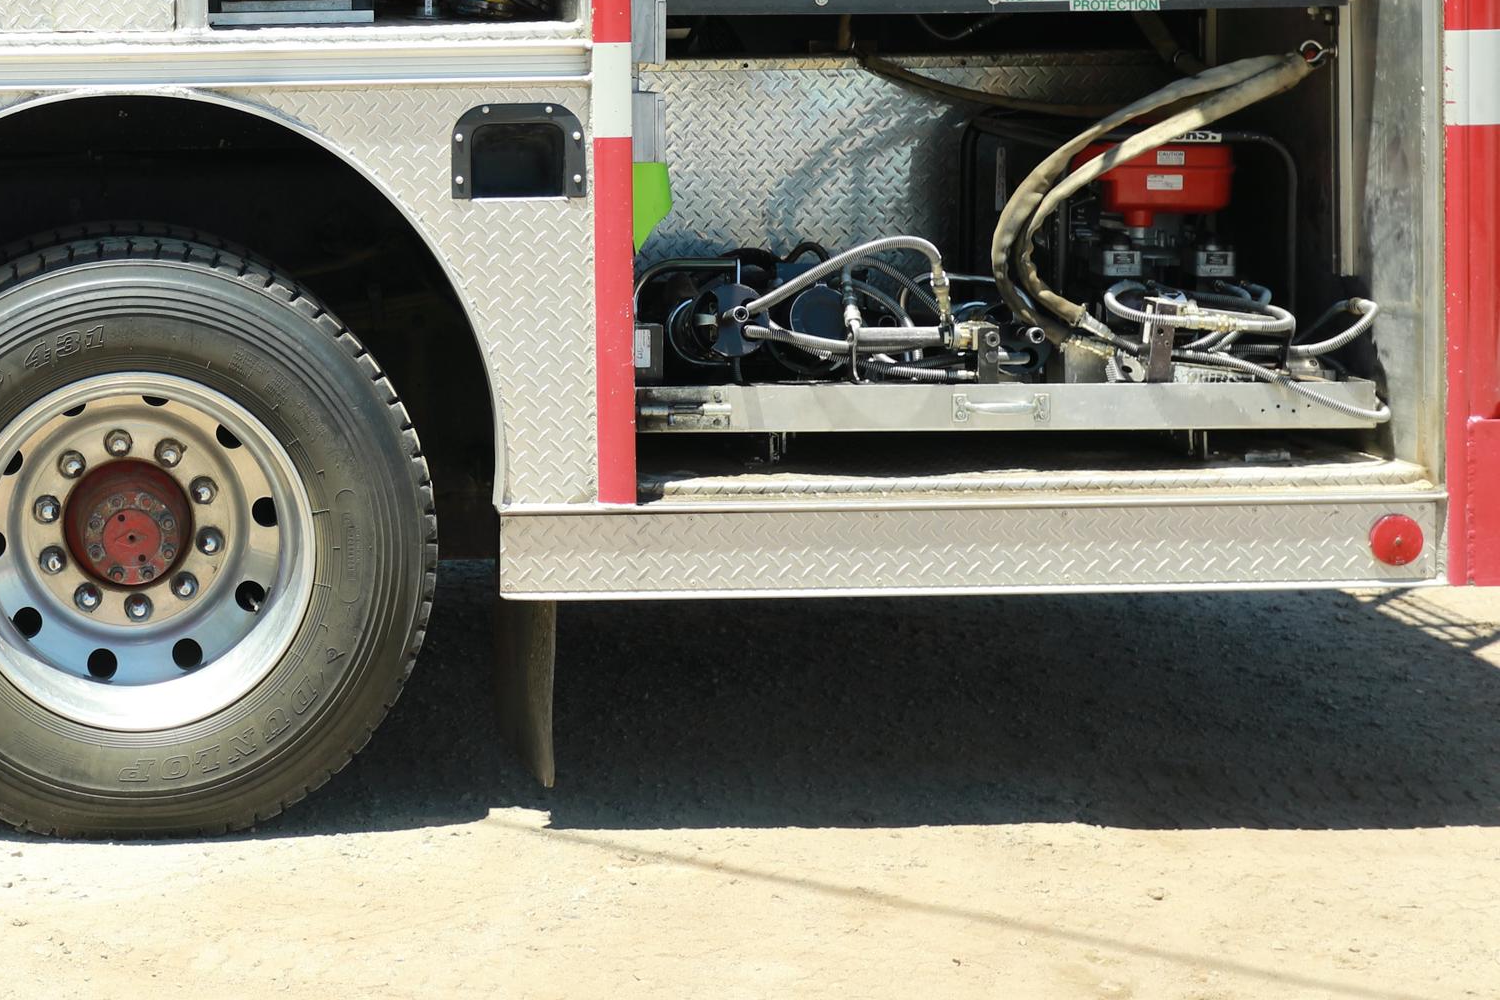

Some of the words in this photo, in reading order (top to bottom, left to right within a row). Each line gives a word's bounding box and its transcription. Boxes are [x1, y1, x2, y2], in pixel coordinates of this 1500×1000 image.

[1072, 0, 1158, 11] PROTECTION
[23, 324, 105, 370] 431
[117, 672, 319, 783] DUNLOP
